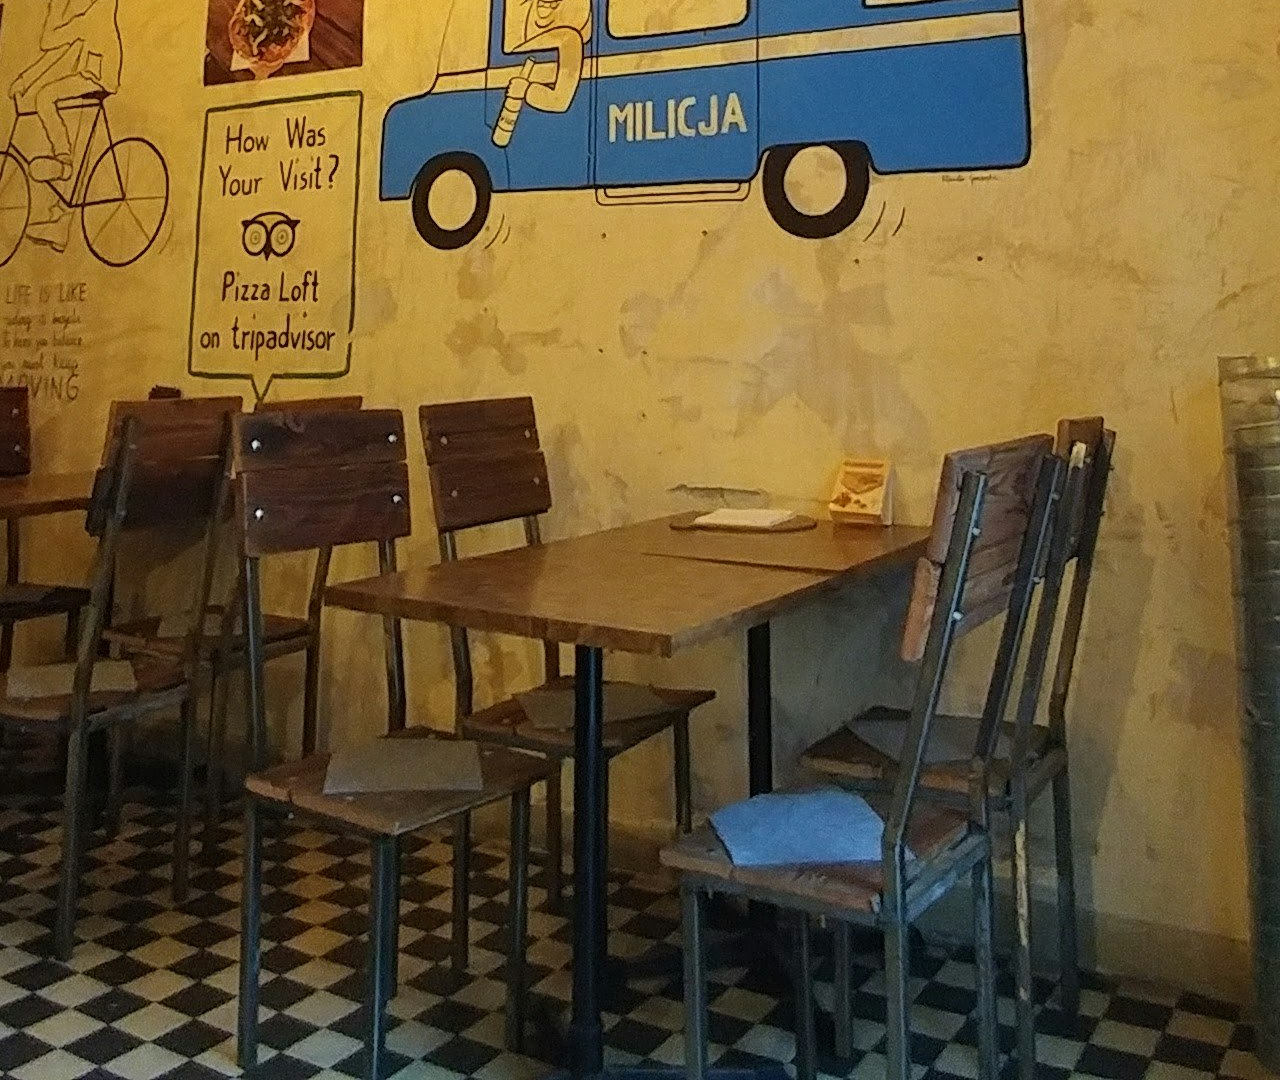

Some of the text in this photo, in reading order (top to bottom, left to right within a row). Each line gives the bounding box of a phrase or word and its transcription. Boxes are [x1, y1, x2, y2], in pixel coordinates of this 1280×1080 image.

[225, 115, 327, 155] How Was
[608, 91, 749, 144] MILICJA
[218, 153, 340, 197] Your Visit?
[58, 281, 88, 303] LIKE
[221, 269, 320, 303] Pizza Loft
[199, 311, 336, 361] on tripadvisor
